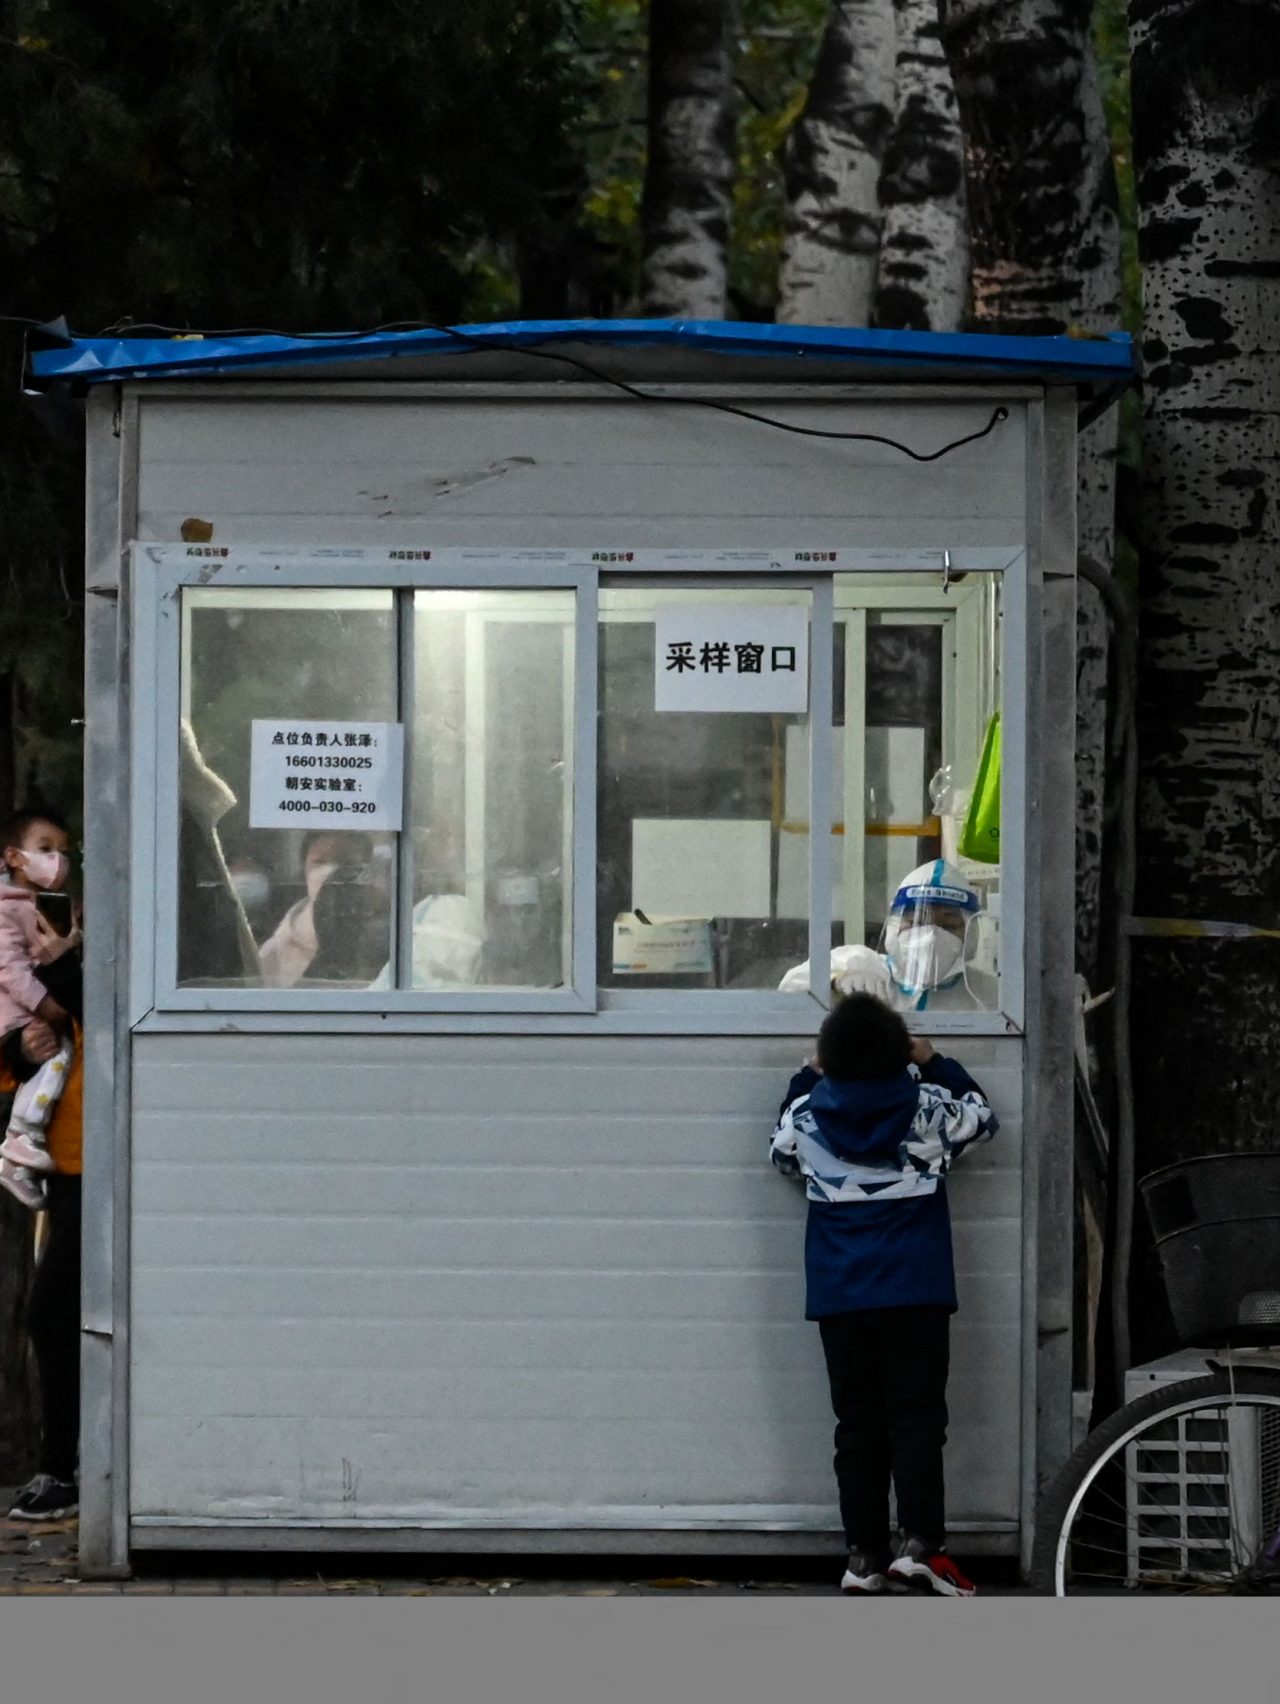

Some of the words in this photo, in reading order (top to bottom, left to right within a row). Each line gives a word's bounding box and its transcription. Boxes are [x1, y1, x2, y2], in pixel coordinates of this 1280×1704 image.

[666, 641, 796, 673] 采样窗口
[286, 756, 373, 768] 16601330025
[279, 800, 376, 813] 4000-030-920
